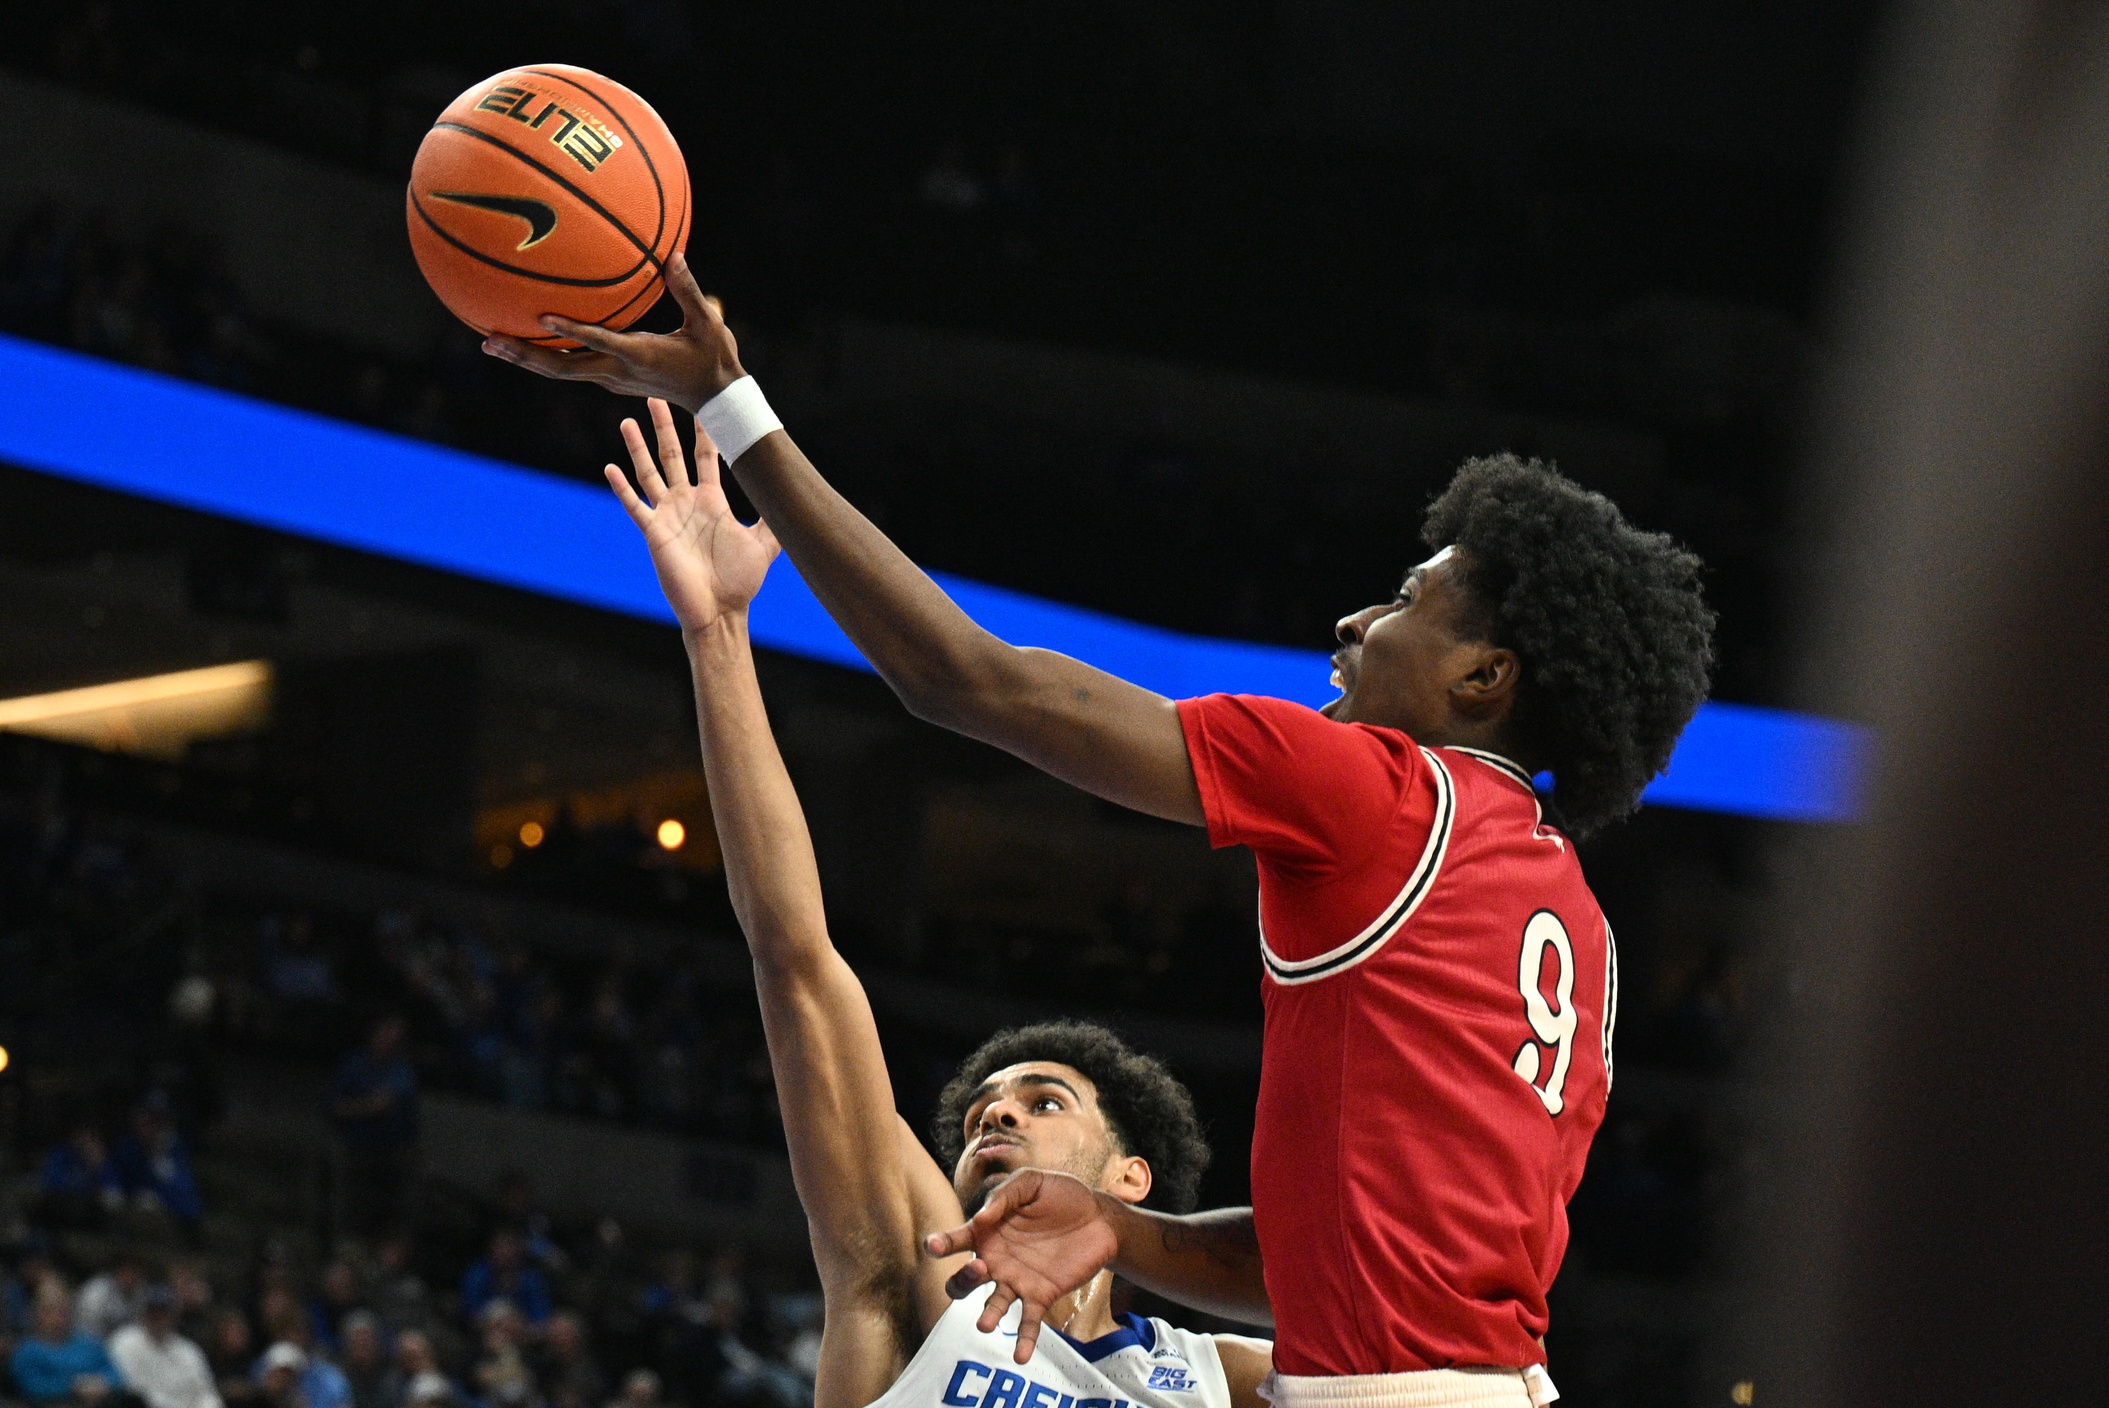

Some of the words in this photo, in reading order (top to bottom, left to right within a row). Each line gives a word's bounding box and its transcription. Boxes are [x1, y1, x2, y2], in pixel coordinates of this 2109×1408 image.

[475, 86, 616, 173] ELITE
[1511, 908, 1578, 1118] 9
[1148, 1377, 1198, 1390] EAST
[1152, 1366, 1188, 1379] BIG
